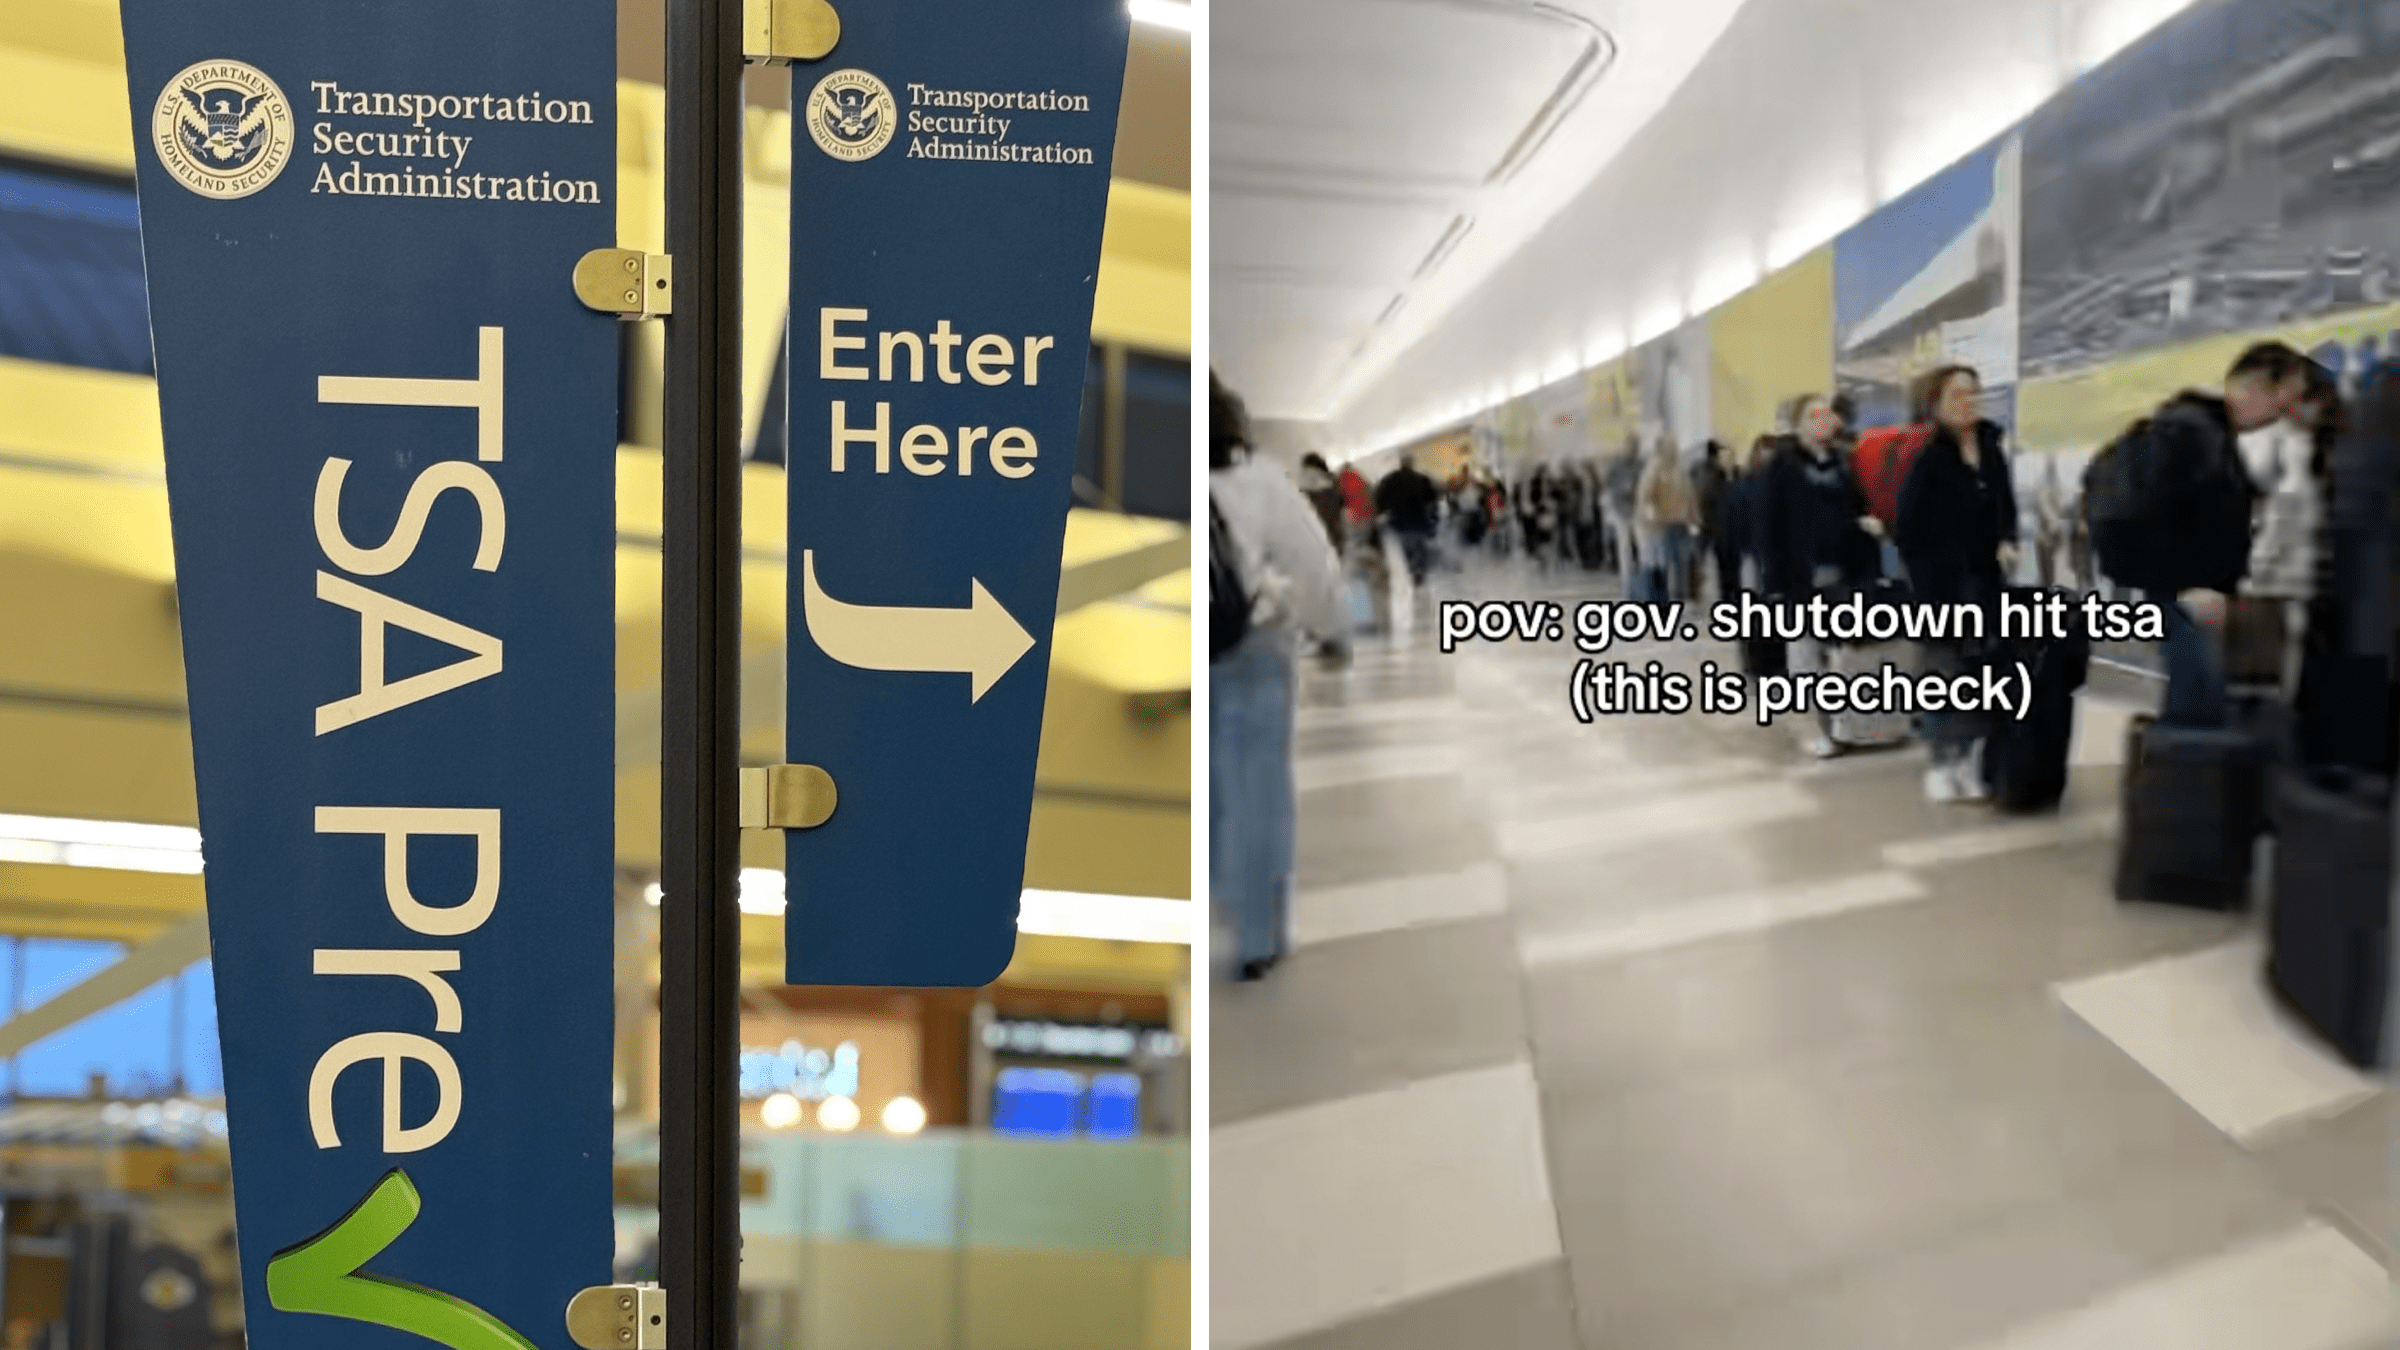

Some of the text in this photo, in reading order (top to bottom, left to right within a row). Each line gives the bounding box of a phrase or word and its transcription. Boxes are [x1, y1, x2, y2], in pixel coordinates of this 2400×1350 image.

[162, 66, 286, 121] U.S. DEPARTMENT OF
[310, 80, 594, 128] Transportation
[826, 74, 885, 97] DEPARTMENT
[882, 98, 891, 110] OF
[907, 83, 1090, 114] Transportation
[312, 122, 472, 170] Security
[812, 118, 891, 156] HOMELAND SECURITY
[908, 110, 1011, 142] Security
[161, 133, 286, 191] HOMELAND SECURITY
[906, 136, 1094, 165] Administration
[310, 161, 601, 204] Administration
[819, 306, 1054, 387] Enter
[830, 400, 1039, 480] Here
[308, 326, 506, 1154] TSA Pre
